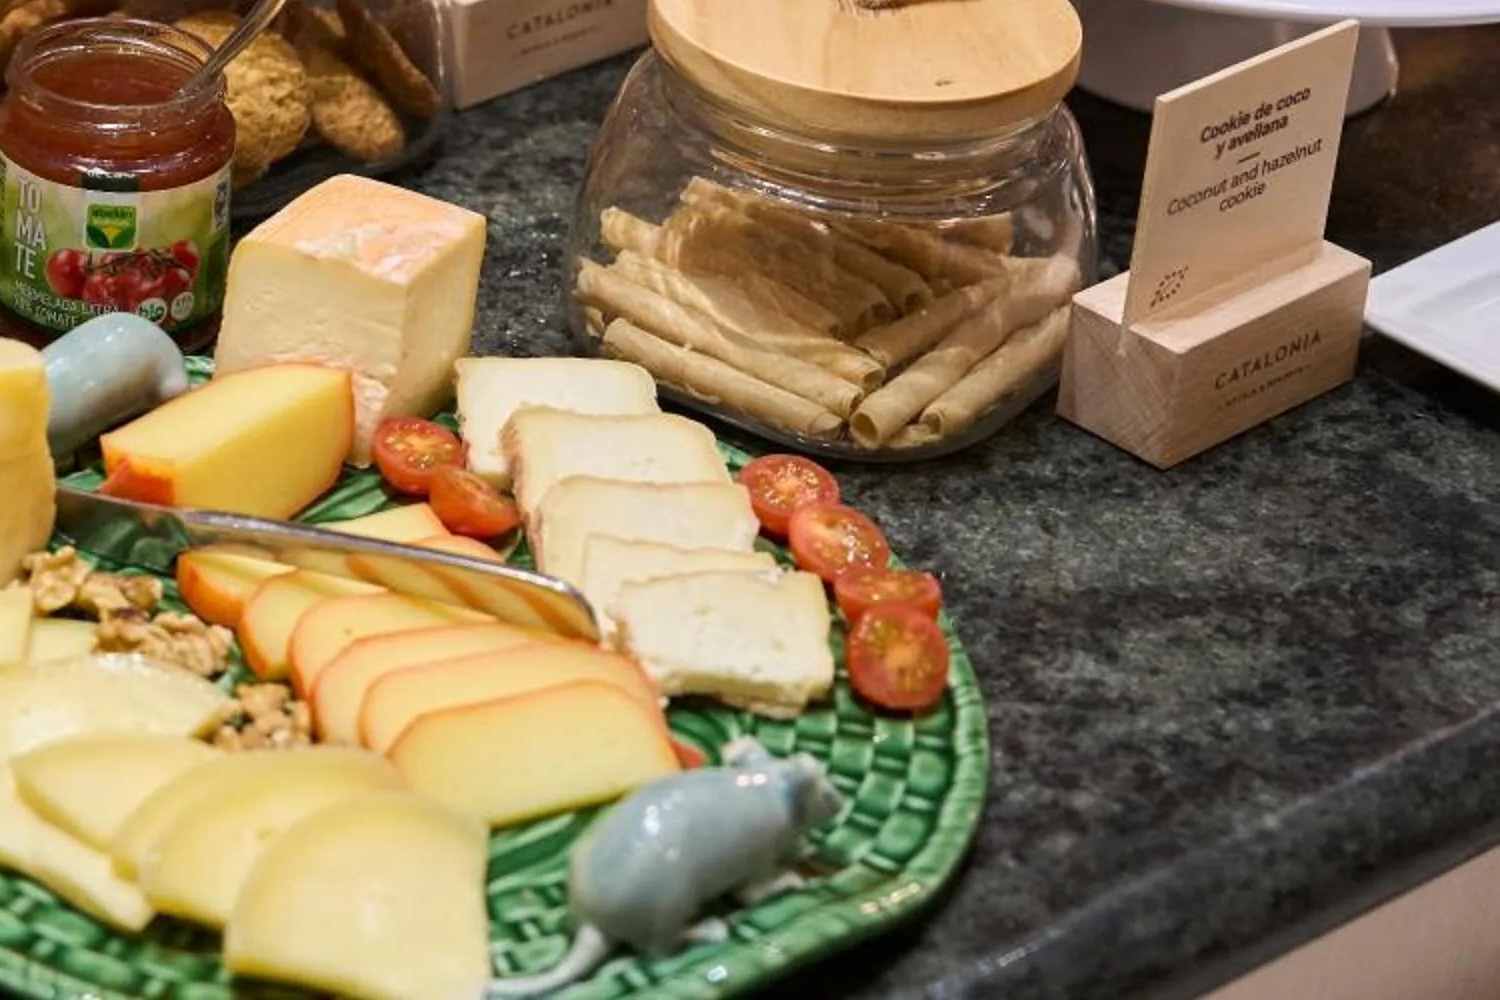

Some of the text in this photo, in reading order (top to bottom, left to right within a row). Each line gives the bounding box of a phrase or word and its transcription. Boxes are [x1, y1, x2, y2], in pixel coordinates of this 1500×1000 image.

[1200, 86, 1311, 144] Cookie de coco
[1213, 114, 1289, 160] y avellana
[18, 179, 42, 214] TO
[1166, 137, 1324, 217] Coconut and hazelnut
[1219, 181, 1267, 214] cookie
[16, 212, 47, 251] MA
[14, 242, 37, 279] TE
[1215, 330, 1321, 390] CATALONIA
